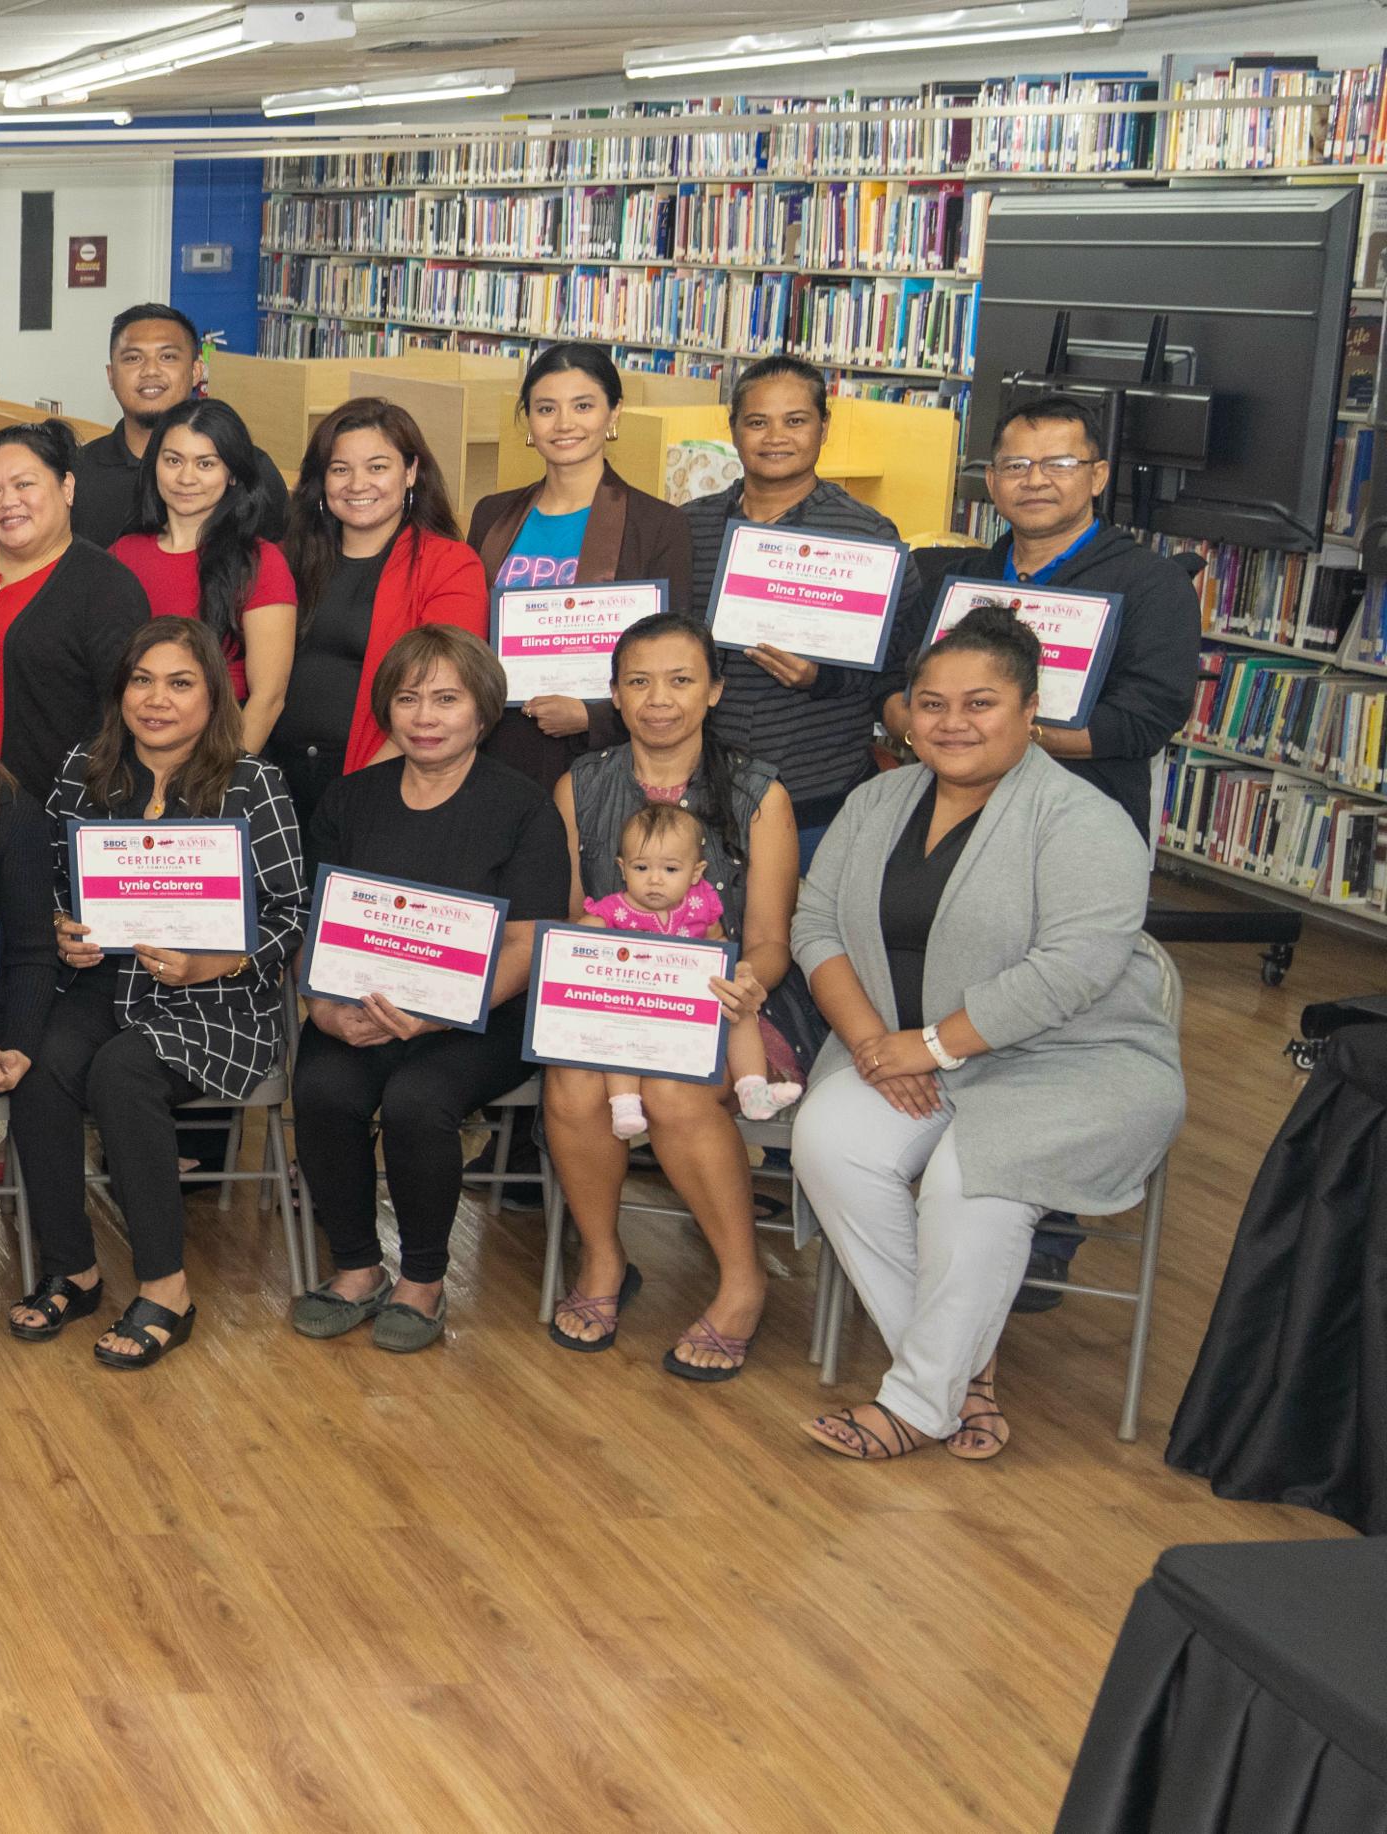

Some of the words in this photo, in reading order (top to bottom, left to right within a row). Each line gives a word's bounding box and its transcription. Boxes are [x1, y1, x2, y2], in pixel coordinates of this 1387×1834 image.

[769, 559, 854, 579] CERTIFICATE
[767, 583, 795, 596] Dina
[798, 587, 843, 602] Tenorio
[538, 614, 620, 624] CERTIFICATE
[522, 638, 550, 647] Elina
[552, 635, 590, 645] Gharti
[593, 634, 620, 644] Chh
[1042, 648, 1059, 659] ina
[118, 856, 201, 864] CERTIFICATE
[119, 880, 150, 893] Lynie
[152, 880, 203, 890] Cabrera
[352, 891, 378, 901] SBDC
[363, 910, 452, 935] CERTIFICATE
[363, 933, 401, 950] Maria
[402, 941, 443, 958] Javier
[572, 946, 599, 956] SBDC
[586, 965, 679, 984] CERTIFICATE
[564, 988, 634, 1006] Anniebeth
[636, 996, 695, 1015] Abibuag
